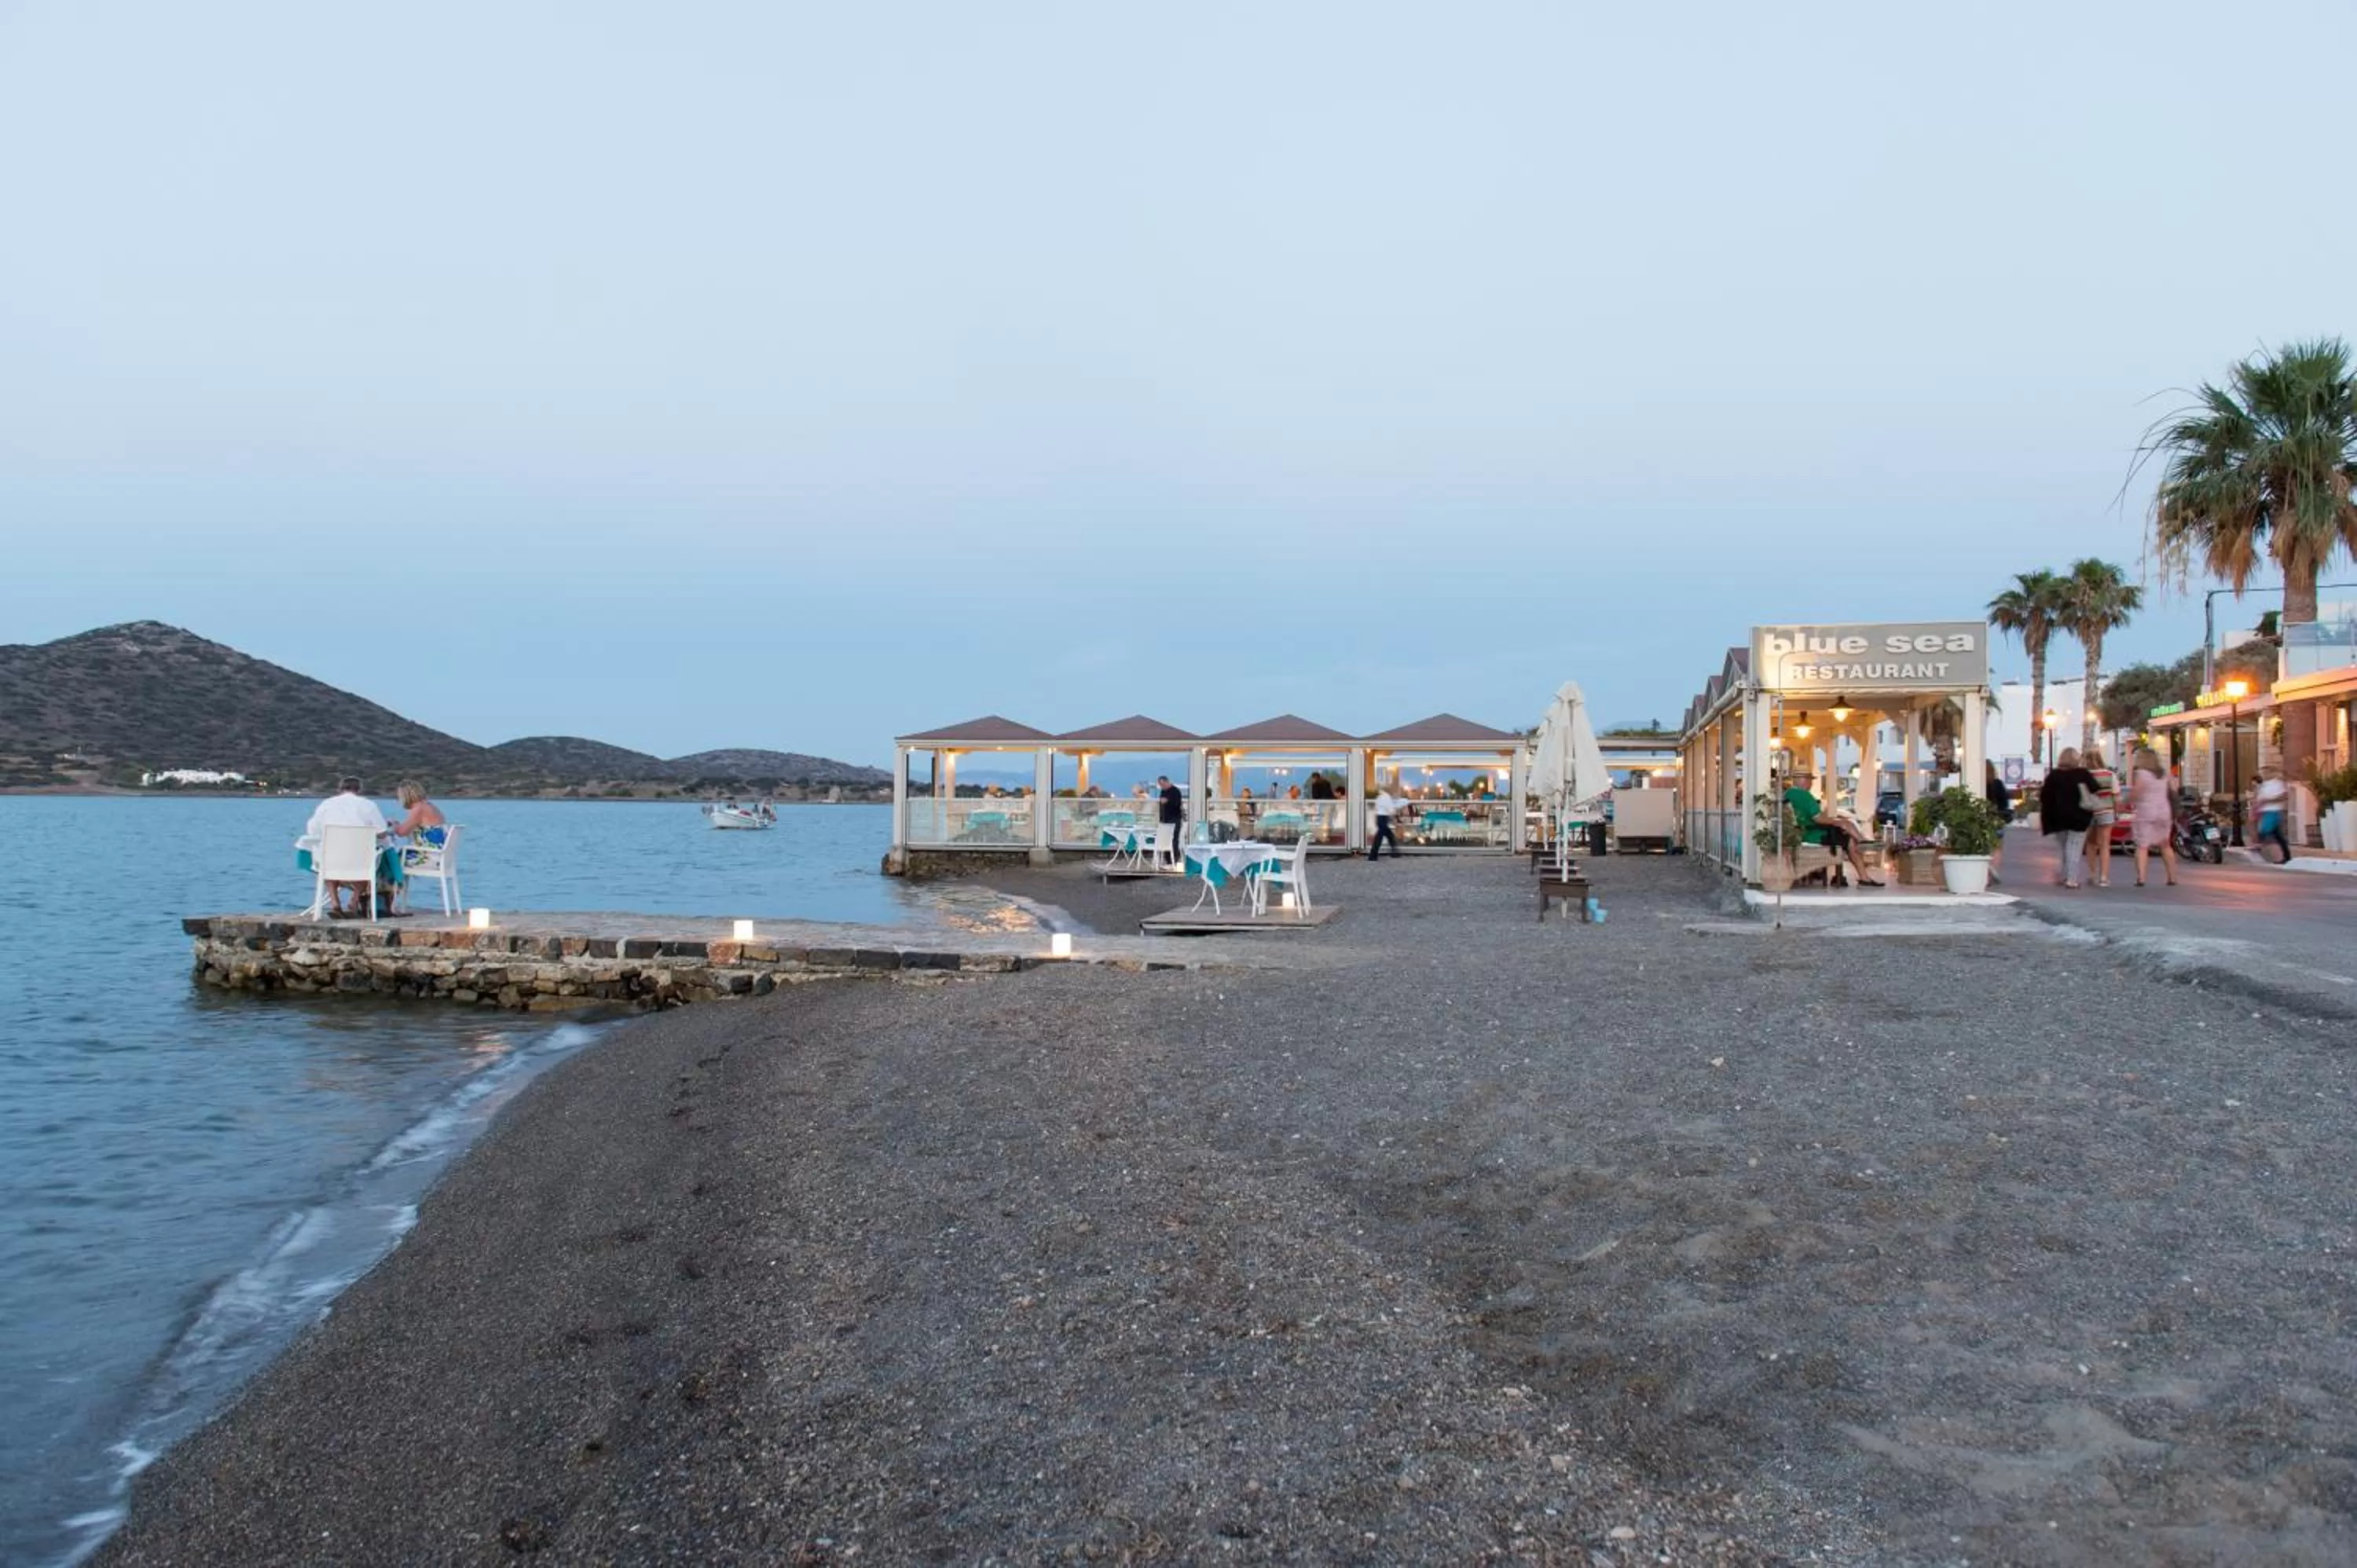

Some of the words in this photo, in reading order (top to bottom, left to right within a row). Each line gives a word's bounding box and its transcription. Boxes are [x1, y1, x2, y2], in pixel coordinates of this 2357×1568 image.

[1764, 632, 1869, 654] blue
[1885, 634, 1974, 653] sea
[1790, 662, 1949, 680] RESTAURANT
